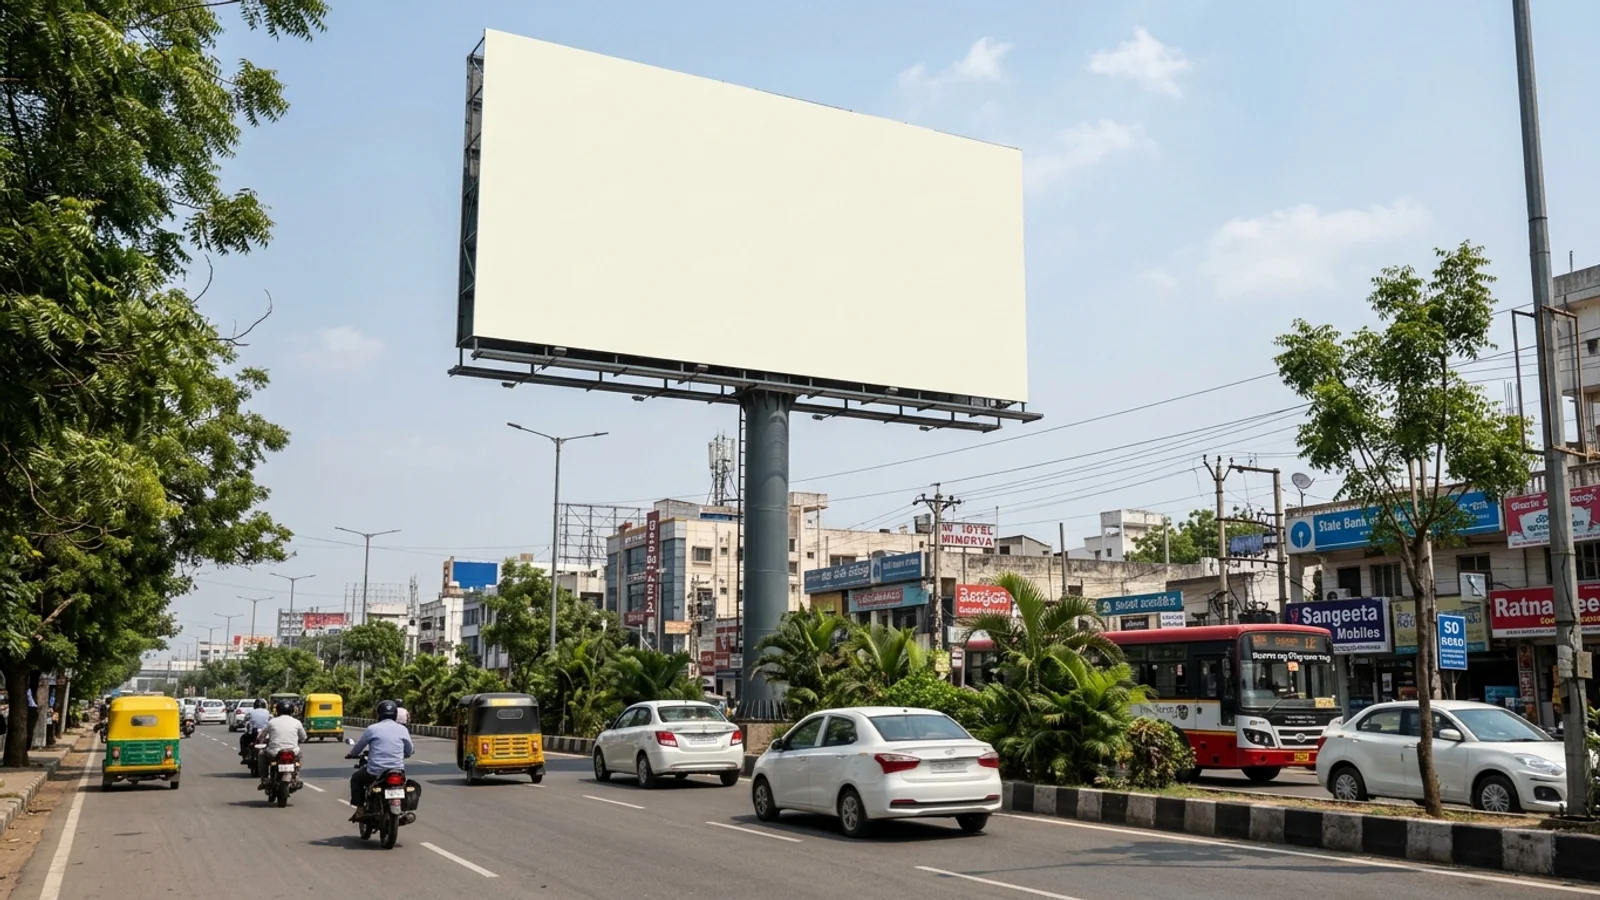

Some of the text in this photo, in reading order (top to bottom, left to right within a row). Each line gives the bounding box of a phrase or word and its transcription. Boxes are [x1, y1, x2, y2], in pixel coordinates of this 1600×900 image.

[1319, 520, 1341, 532] State
[1344, 515, 1367, 529] Bank
[1302, 605, 1378, 627] Sangeeta
[1337, 626, 1380, 639] Mobiles
